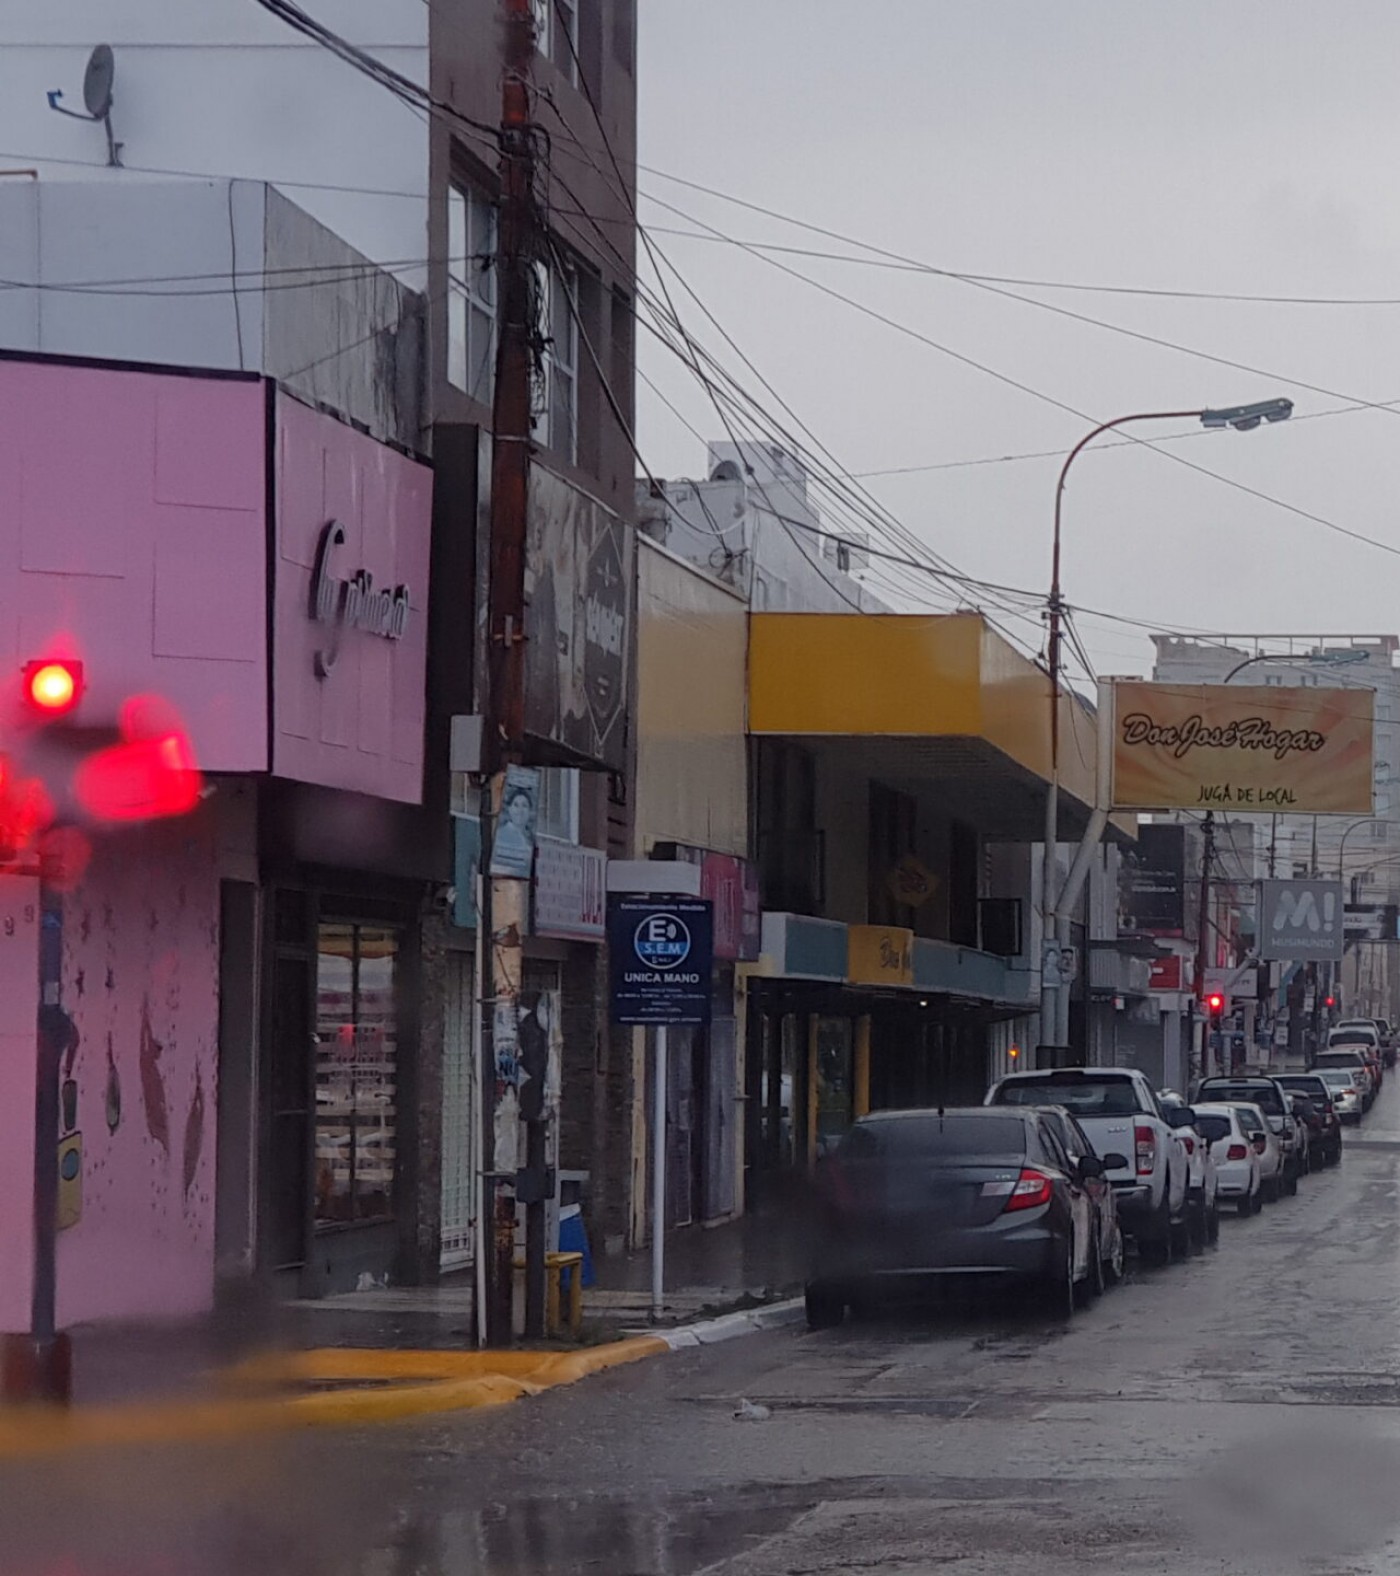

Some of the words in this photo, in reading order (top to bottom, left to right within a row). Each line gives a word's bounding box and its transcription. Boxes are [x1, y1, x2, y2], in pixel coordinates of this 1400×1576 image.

[1123, 713, 1180, 745] Don
[1174, 715, 1239, 758] José
[1236, 717, 1326, 760] Hogar
[1236, 786, 1255, 802] DE
[1258, 786, 1298, 805] LOCAL
[624, 972, 662, 983] UNICA
[663, 973, 700, 984] MANO
